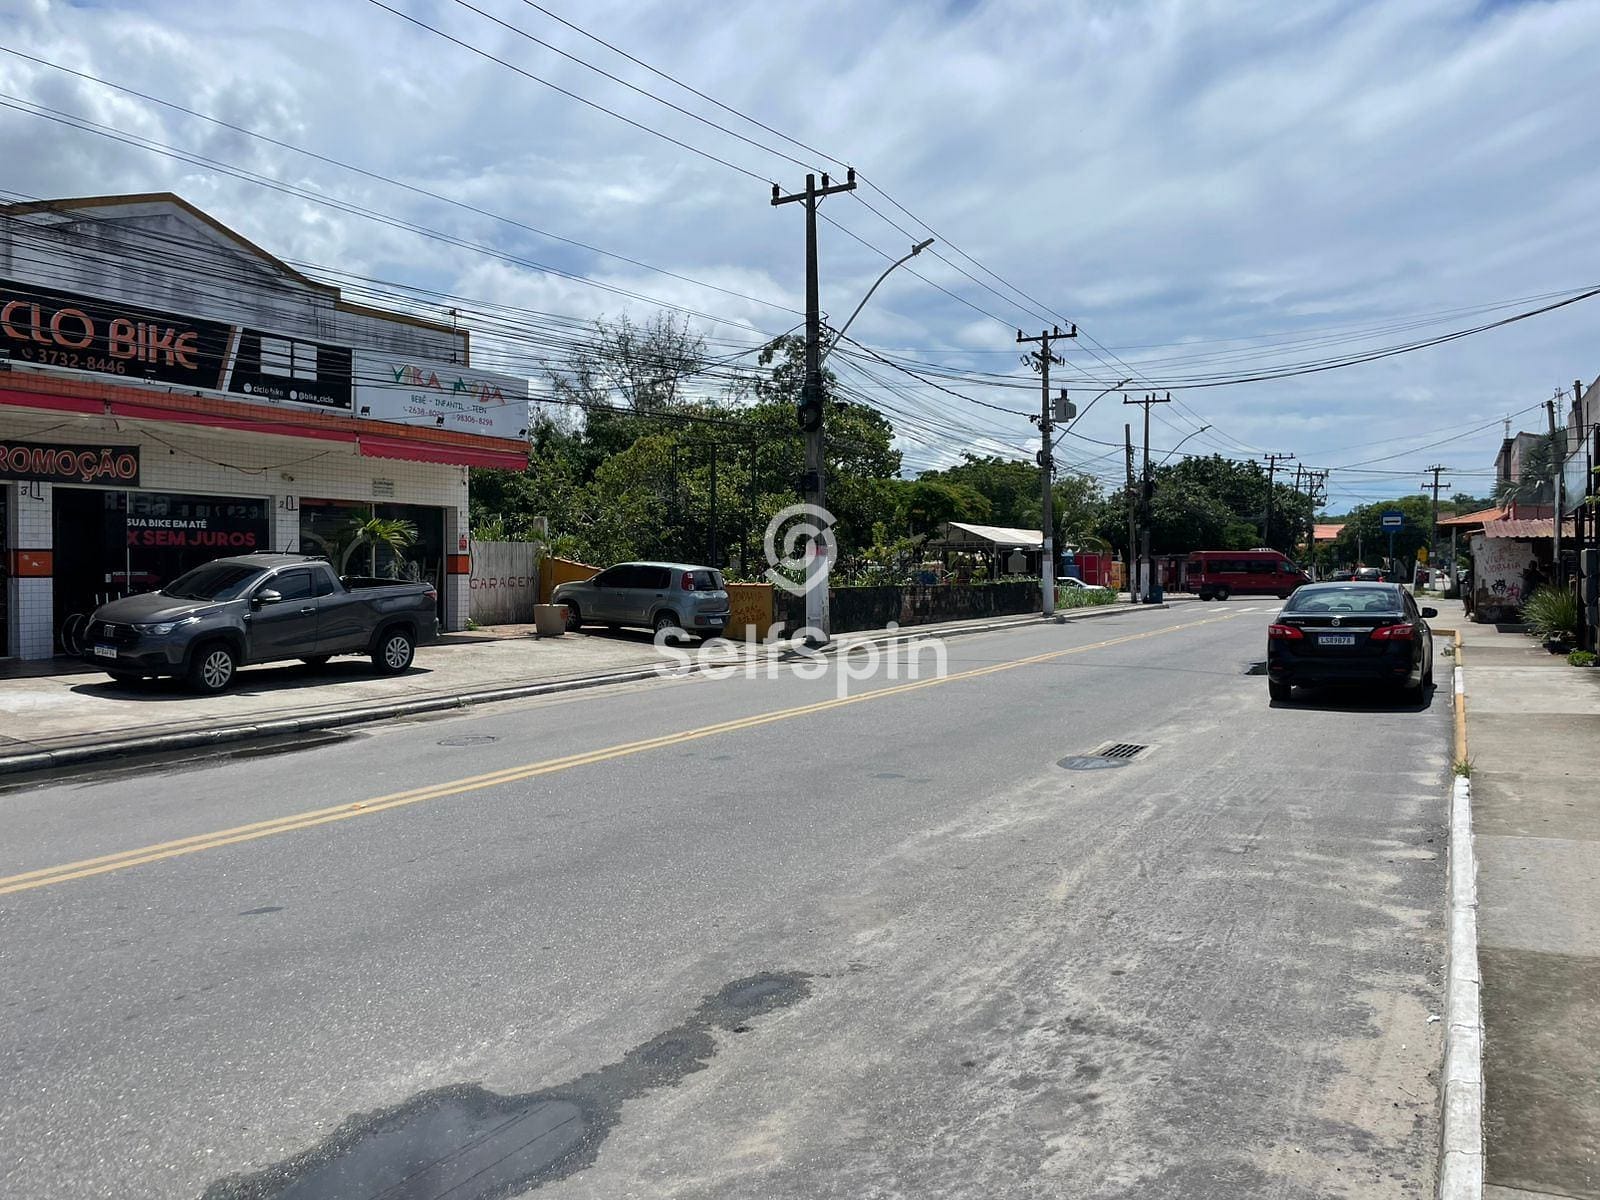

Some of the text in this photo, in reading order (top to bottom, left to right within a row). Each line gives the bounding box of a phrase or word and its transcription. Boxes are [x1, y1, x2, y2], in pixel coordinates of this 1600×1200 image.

[108, 318, 198, 370] BIKE
[38, 348, 126, 375] 3732-8446
[434, 398, 464, 411] INFANTIL
[148, 519, 171, 528] BIKE
[172, 520, 188, 528] EM
[188, 518, 207, 529] ATÉ
[143, 530, 186, 546] SEM
[190, 531, 256, 547] JUROS
[469, 576, 536, 590] GARAGEM
